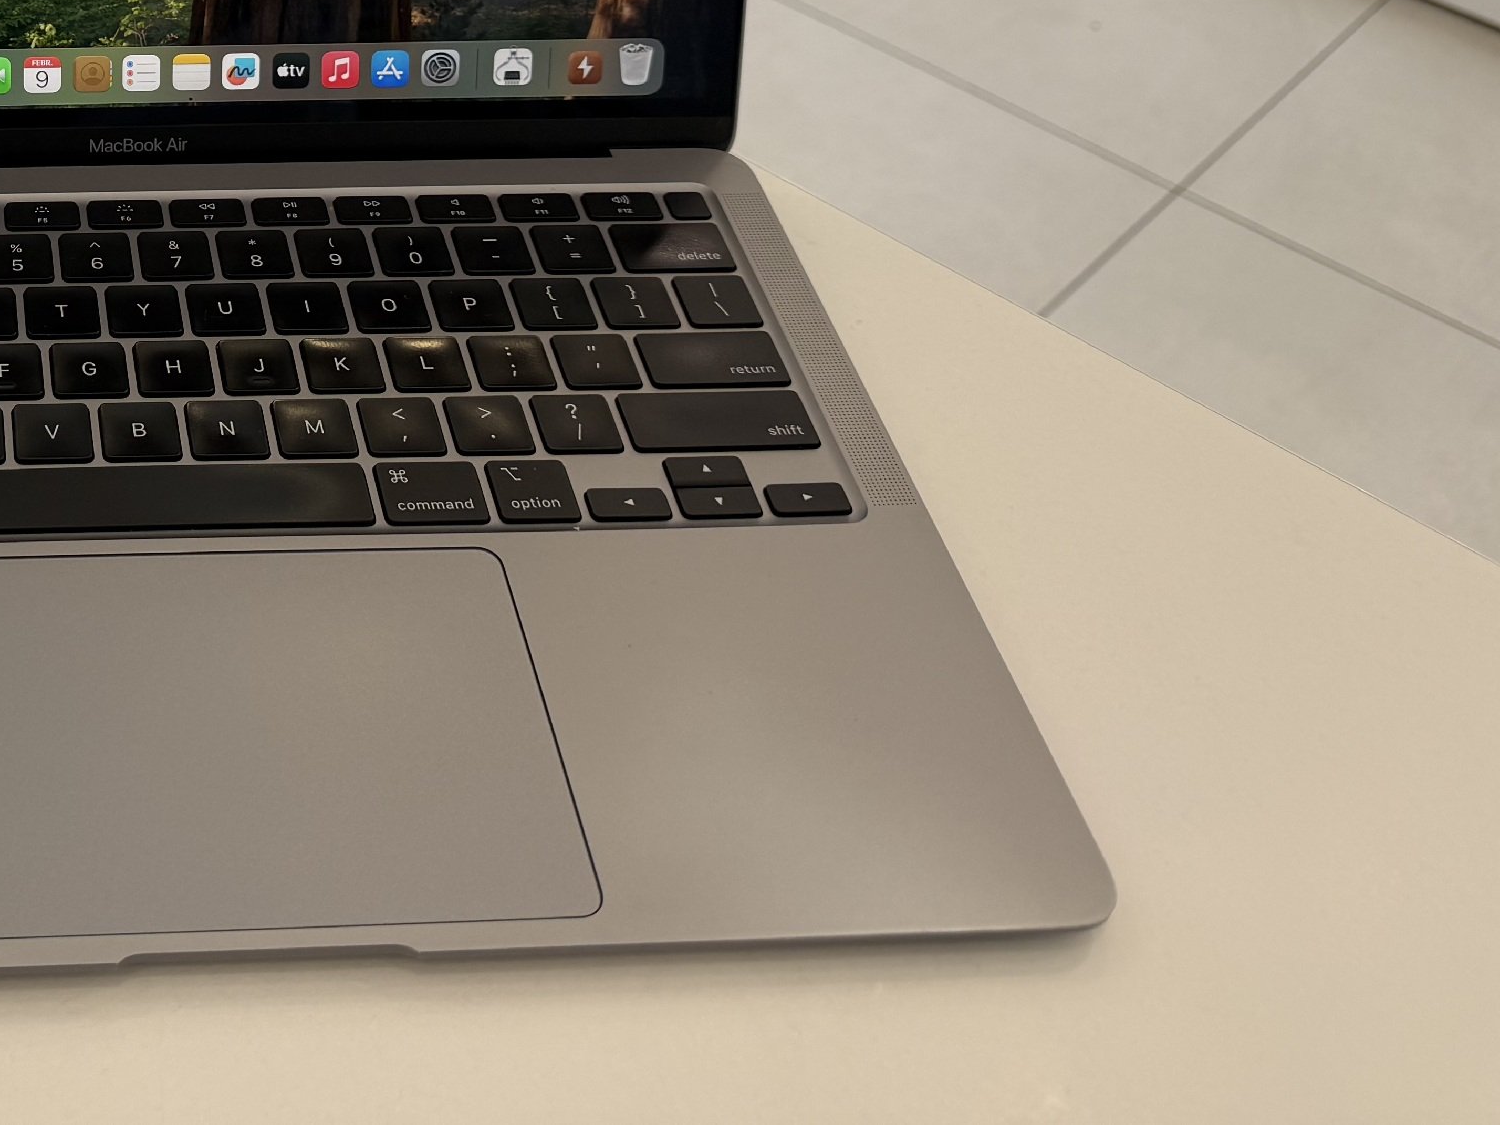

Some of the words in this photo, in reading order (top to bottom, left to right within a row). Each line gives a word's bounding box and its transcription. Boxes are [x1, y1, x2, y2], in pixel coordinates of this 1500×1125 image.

[35, 69, 49, 88] 9
[89, 139, 162, 152] MacBook
[166, 138, 188, 151] Air
[12, 259, 24, 272] 5
[91, 257, 104, 270] 6
[170, 255, 182, 268] 7
[54, 304, 69, 318] T
[136, 303, 150, 316] Y
[217, 300, 233, 315] U
[462, 297, 477, 311] P
[81, 361, 97, 376] G
[165, 359, 182, 374] H
[253, 358, 265, 373] J
[334, 356, 350, 371] K
[419, 355, 434, 370] L
[729, 365, 777, 374] return
[44, 424, 60, 440] V
[131, 422, 147, 437] B
[218, 420, 236, 436] N
[304, 419, 325, 434] M
[767, 424, 805, 436] shift
[397, 498, 475, 511] command
[511, 496, 561, 511] option
